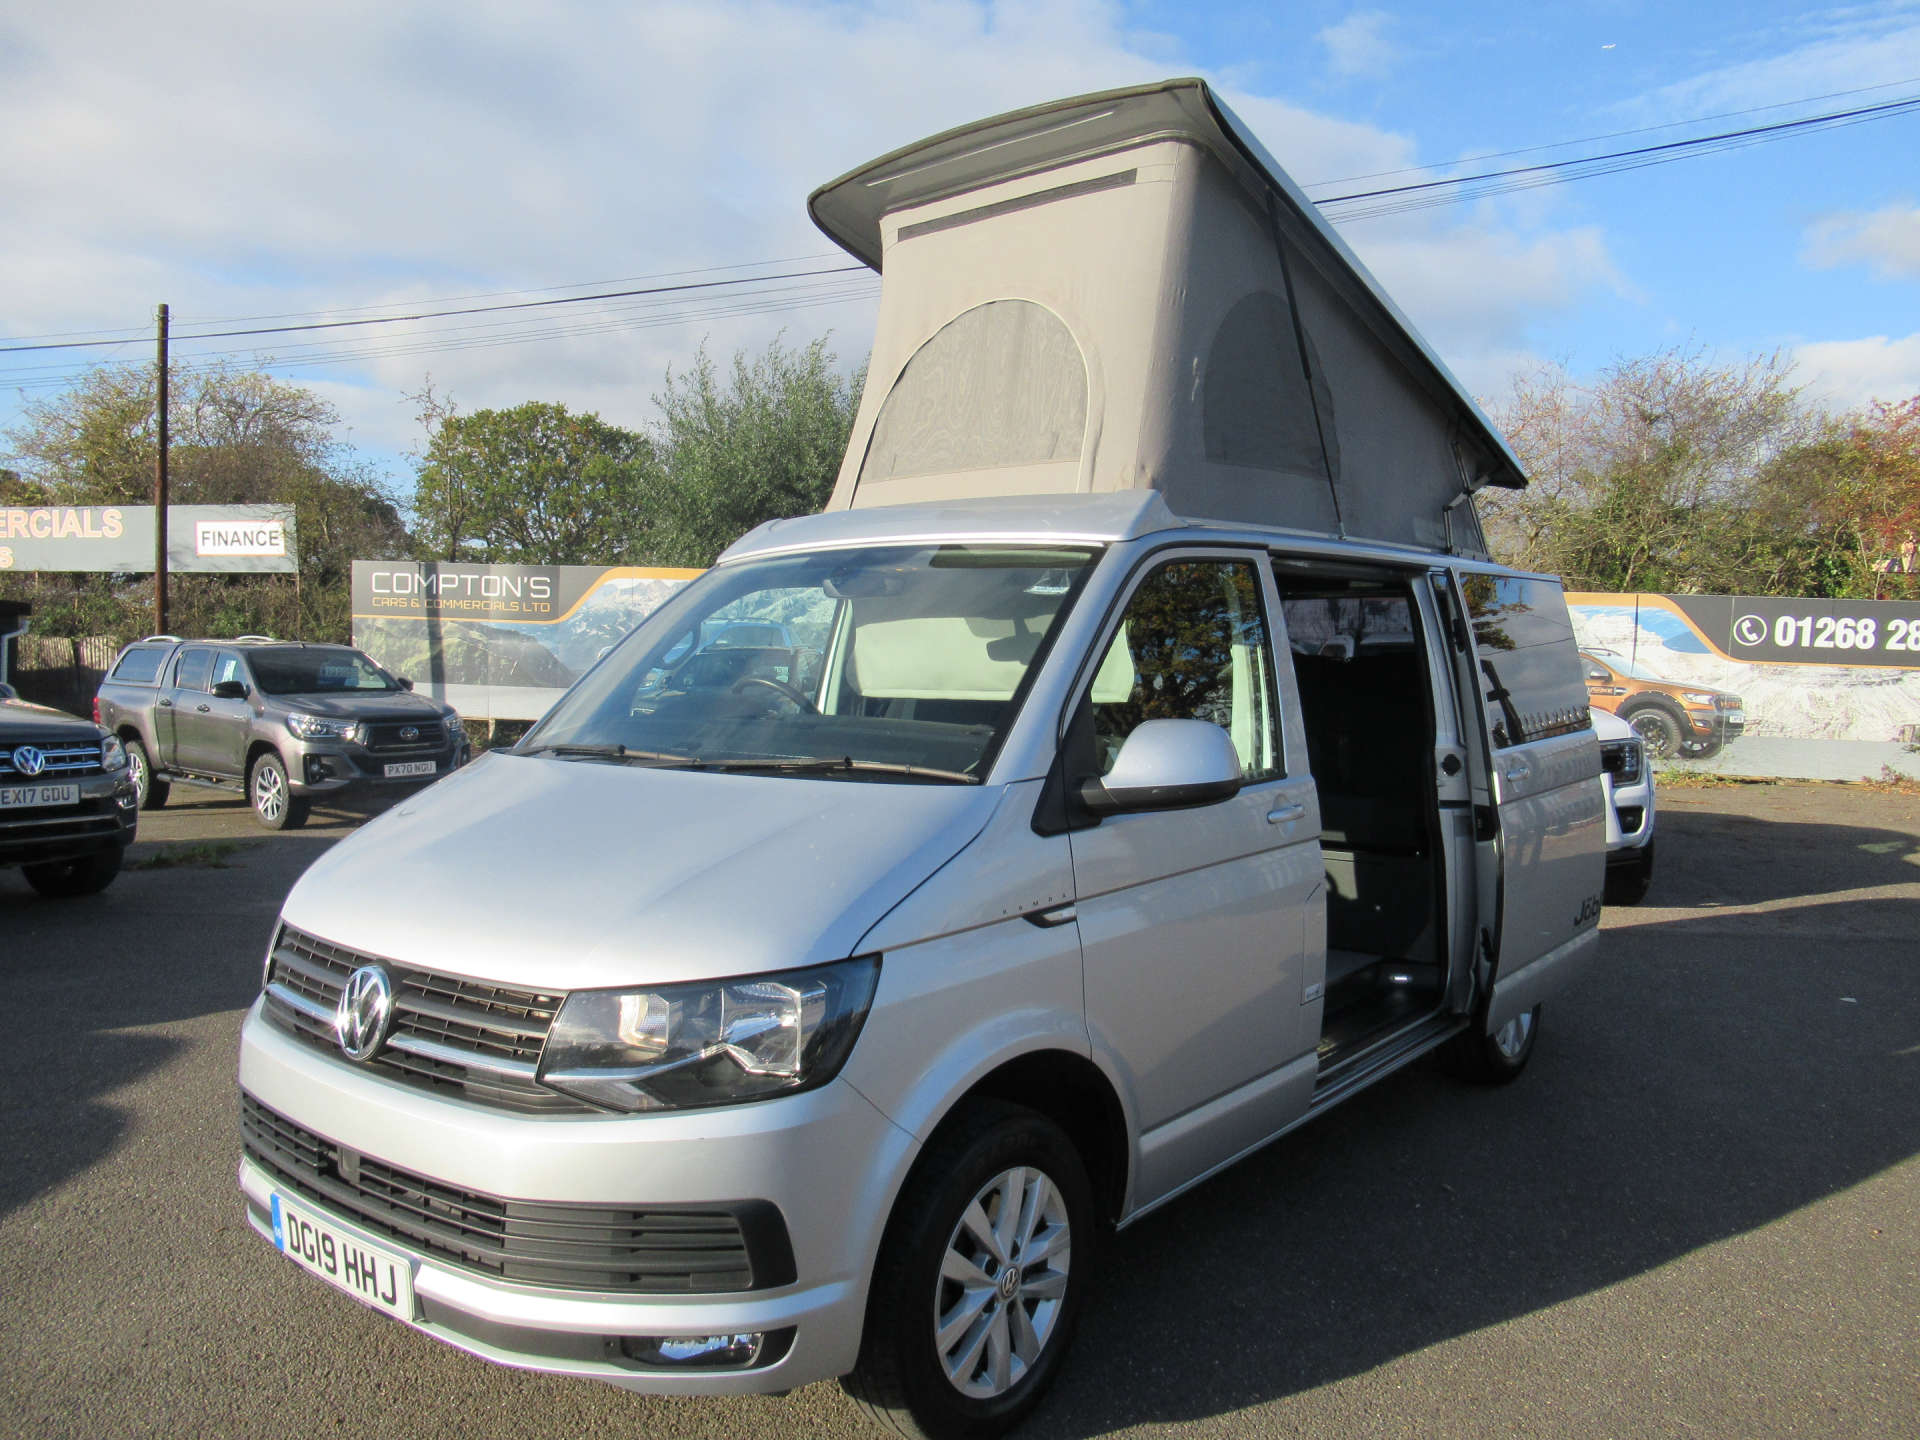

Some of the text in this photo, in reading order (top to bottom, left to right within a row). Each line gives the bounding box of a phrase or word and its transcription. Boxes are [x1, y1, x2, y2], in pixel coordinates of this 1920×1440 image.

[201, 530, 280, 547] FINANCE
[371, 572, 551, 599] COMPTON'S
[371, 597, 551, 613] CARS & COMMERCIALS LTD
[1774, 615, 1876, 650] 01268
[0, 786, 71, 805] EX17 GDU
[286, 1211, 397, 1306] DG19 HHJ
